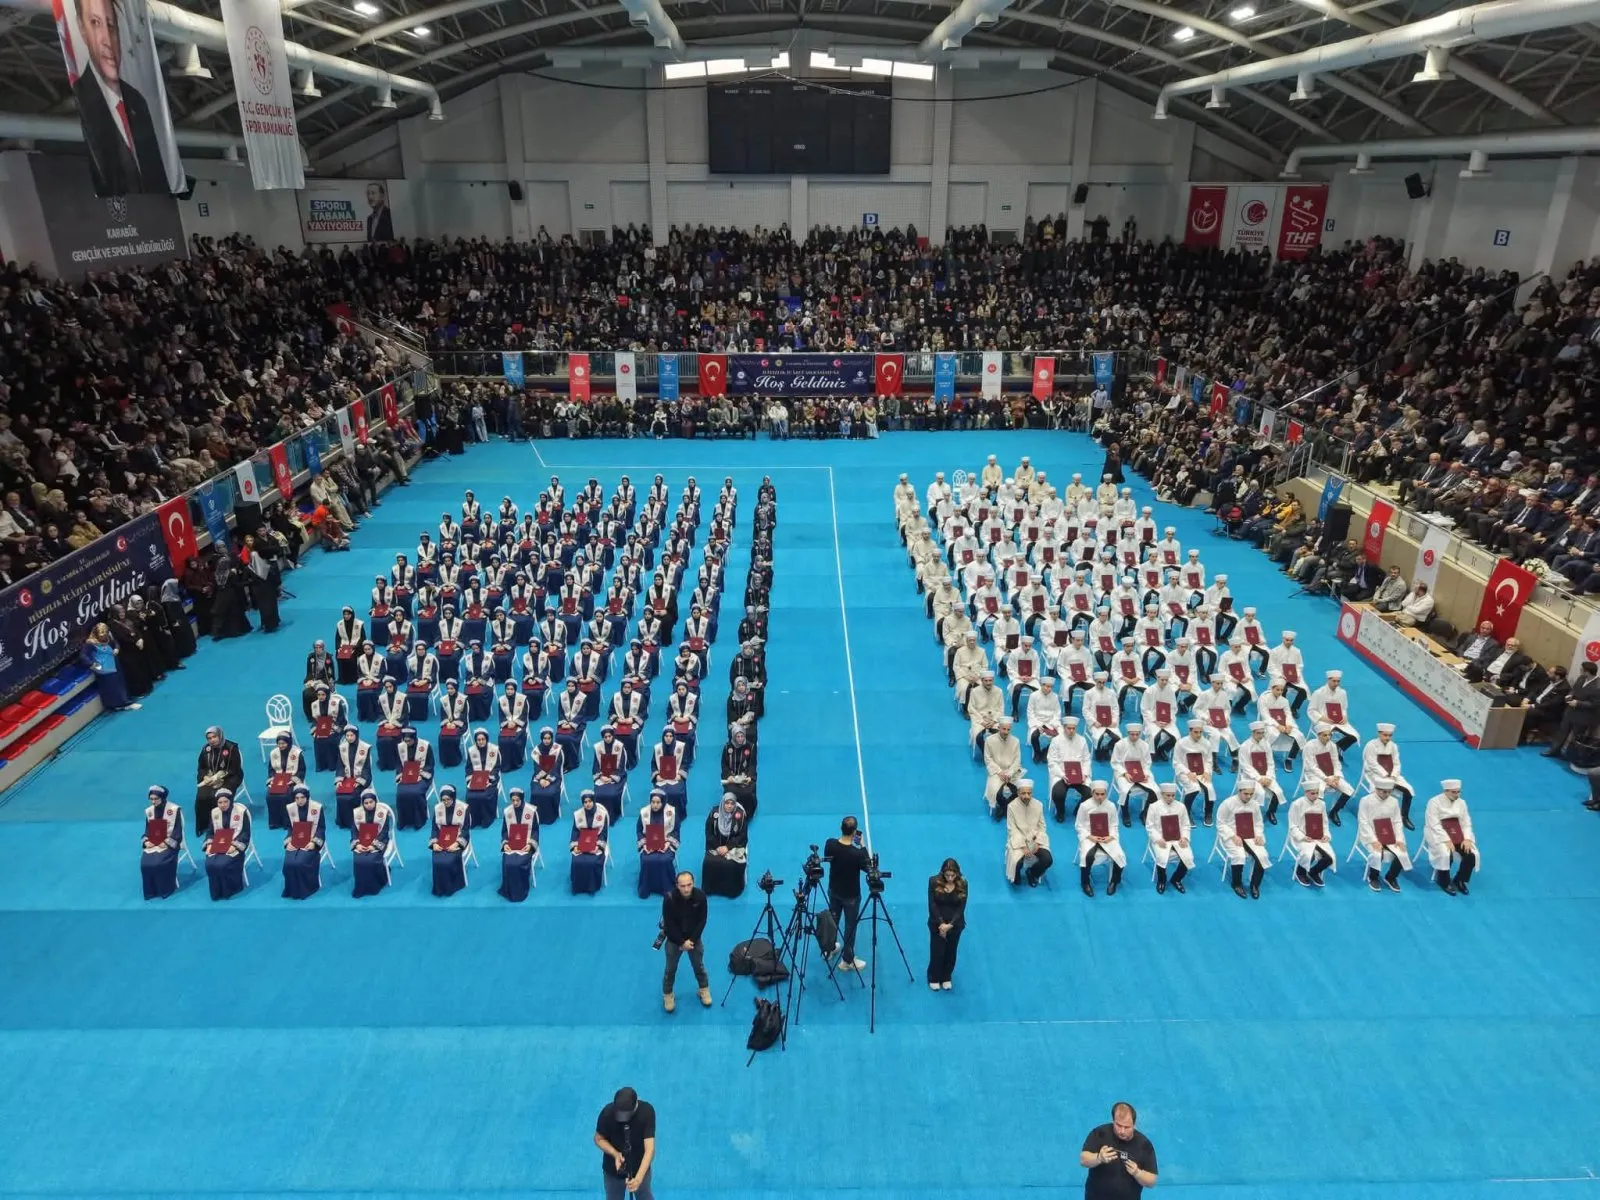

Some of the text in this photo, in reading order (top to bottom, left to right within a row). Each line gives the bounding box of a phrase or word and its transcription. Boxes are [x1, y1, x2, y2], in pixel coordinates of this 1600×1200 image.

[283, 107, 293, 119] VE
[313, 201, 347, 210] SPORU
[312, 211, 352, 220] TABANA
[866, 214, 876, 224] D
[106, 225, 139, 239] KARABÜK
[308, 221, 361, 230] YAYIYORUZ
[1285, 231, 1316, 244] THF
[1496, 231, 1508, 244] B
[72, 245, 101, 262] GENÇLİK
[101, 247, 112, 259] VE
[111, 245, 129, 257] SPOR
[753, 375, 848, 391] Hoş Geldiniz
[24, 570, 146, 659] Hoş Geldiniz
